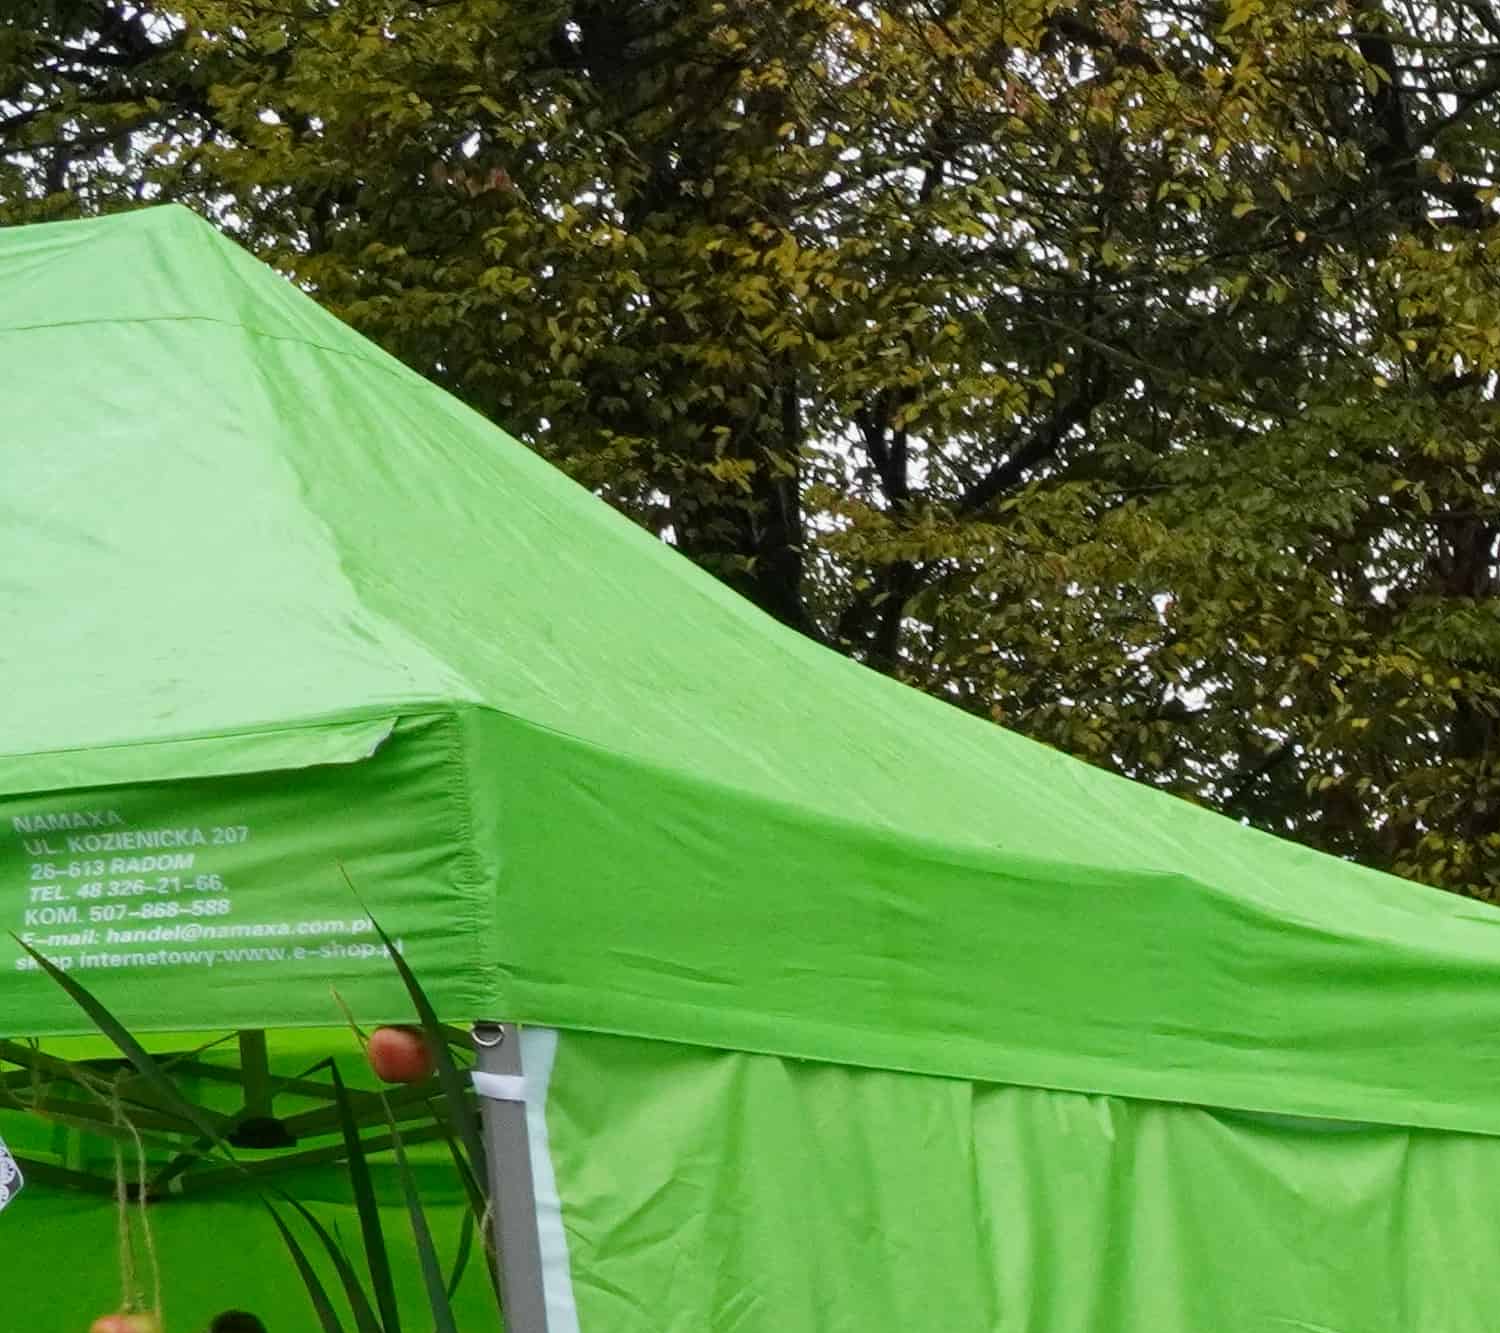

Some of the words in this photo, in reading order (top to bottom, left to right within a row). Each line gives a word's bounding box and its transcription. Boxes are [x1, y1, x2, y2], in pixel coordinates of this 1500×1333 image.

[12, 809, 126, 832] NAMAXA
[66, 828, 207, 853] KOZIENICKA
[211, 826, 249, 845] 207
[31, 859, 105, 880] 26-613
[110, 853, 196, 874] RADOM
[29, 885, 70, 902] TEL.
[76, 881, 102, 899] 48
[24, 906, 83, 926] KOM.
[105, 918, 373, 945] handel@namaxa.com.pl
